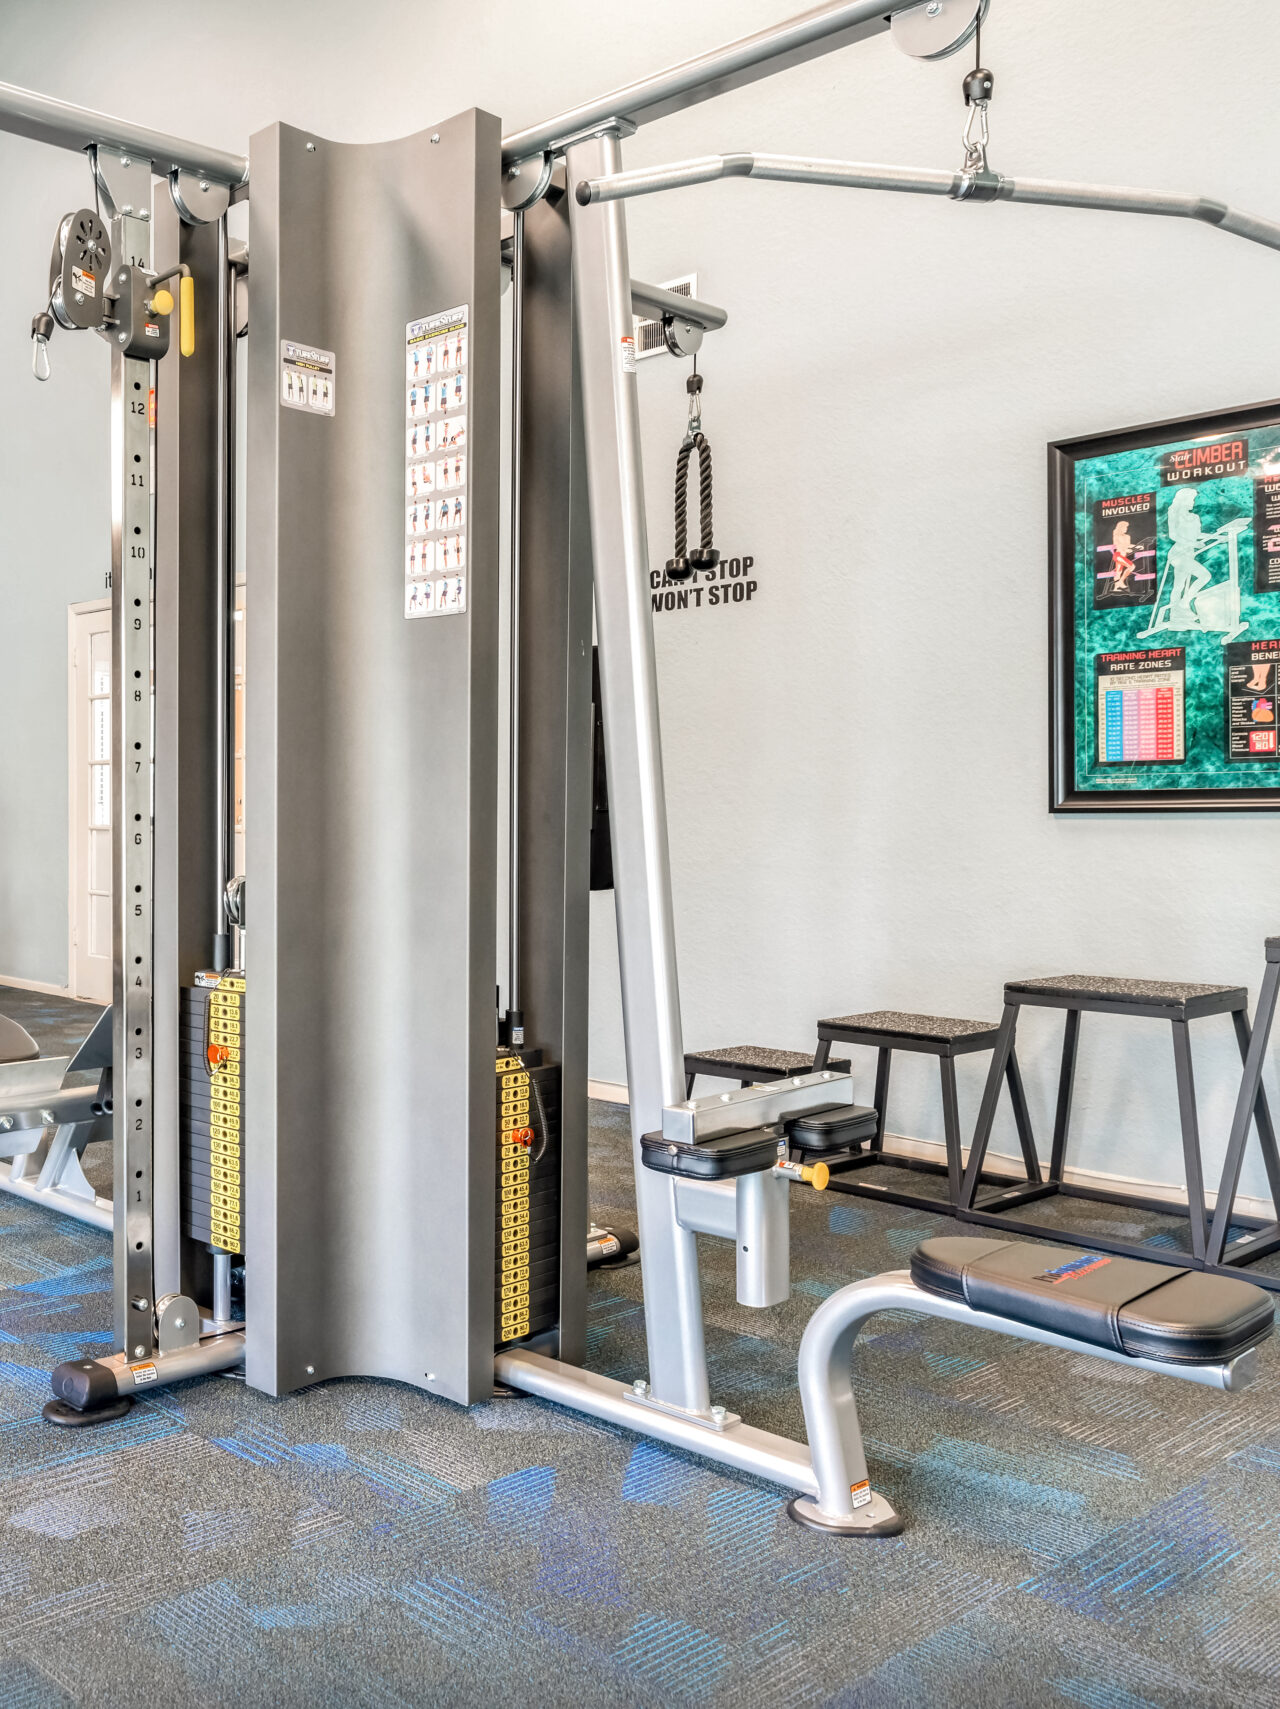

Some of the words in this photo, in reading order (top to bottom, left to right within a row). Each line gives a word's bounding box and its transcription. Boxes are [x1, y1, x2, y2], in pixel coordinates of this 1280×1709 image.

[131, 256, 145, 268] 14
[131, 401, 145, 415] 12
[1169, 453, 1192, 463] Stair
[1174, 441, 1243, 469] CLIMBER
[1166, 460, 1246, 482] WORKOUT
[131, 474, 144, 487] 11
[1102, 494, 1151, 508] MUSCLES
[1102, 502, 1150, 517] INVOLVED
[131, 546, 146, 558] 10
[652, 587, 704, 612] WON'T
[708, 580, 758, 606] STOP
[134, 618, 142, 630] 9
[1251, 640, 1280, 651] HEA
[1100, 651, 1146, 662] TRAINING
[1148, 648, 1182, 658] HEART
[1110, 662, 1135, 672] RATE
[1138, 660, 1172, 670] ZONES
[134, 690, 142, 702] 8
[1252, 732, 1268, 740] 120
[1255, 741, 1268, 750] 80
[134, 762, 141, 773] 7
[134, 833, 142, 845] 6
[134, 904, 142, 916] 5
[135, 976, 142, 987] 4
[135, 1048, 142, 1059] 3
[135, 1118, 143, 1131] 2
[136, 1190, 142, 1202] 1
